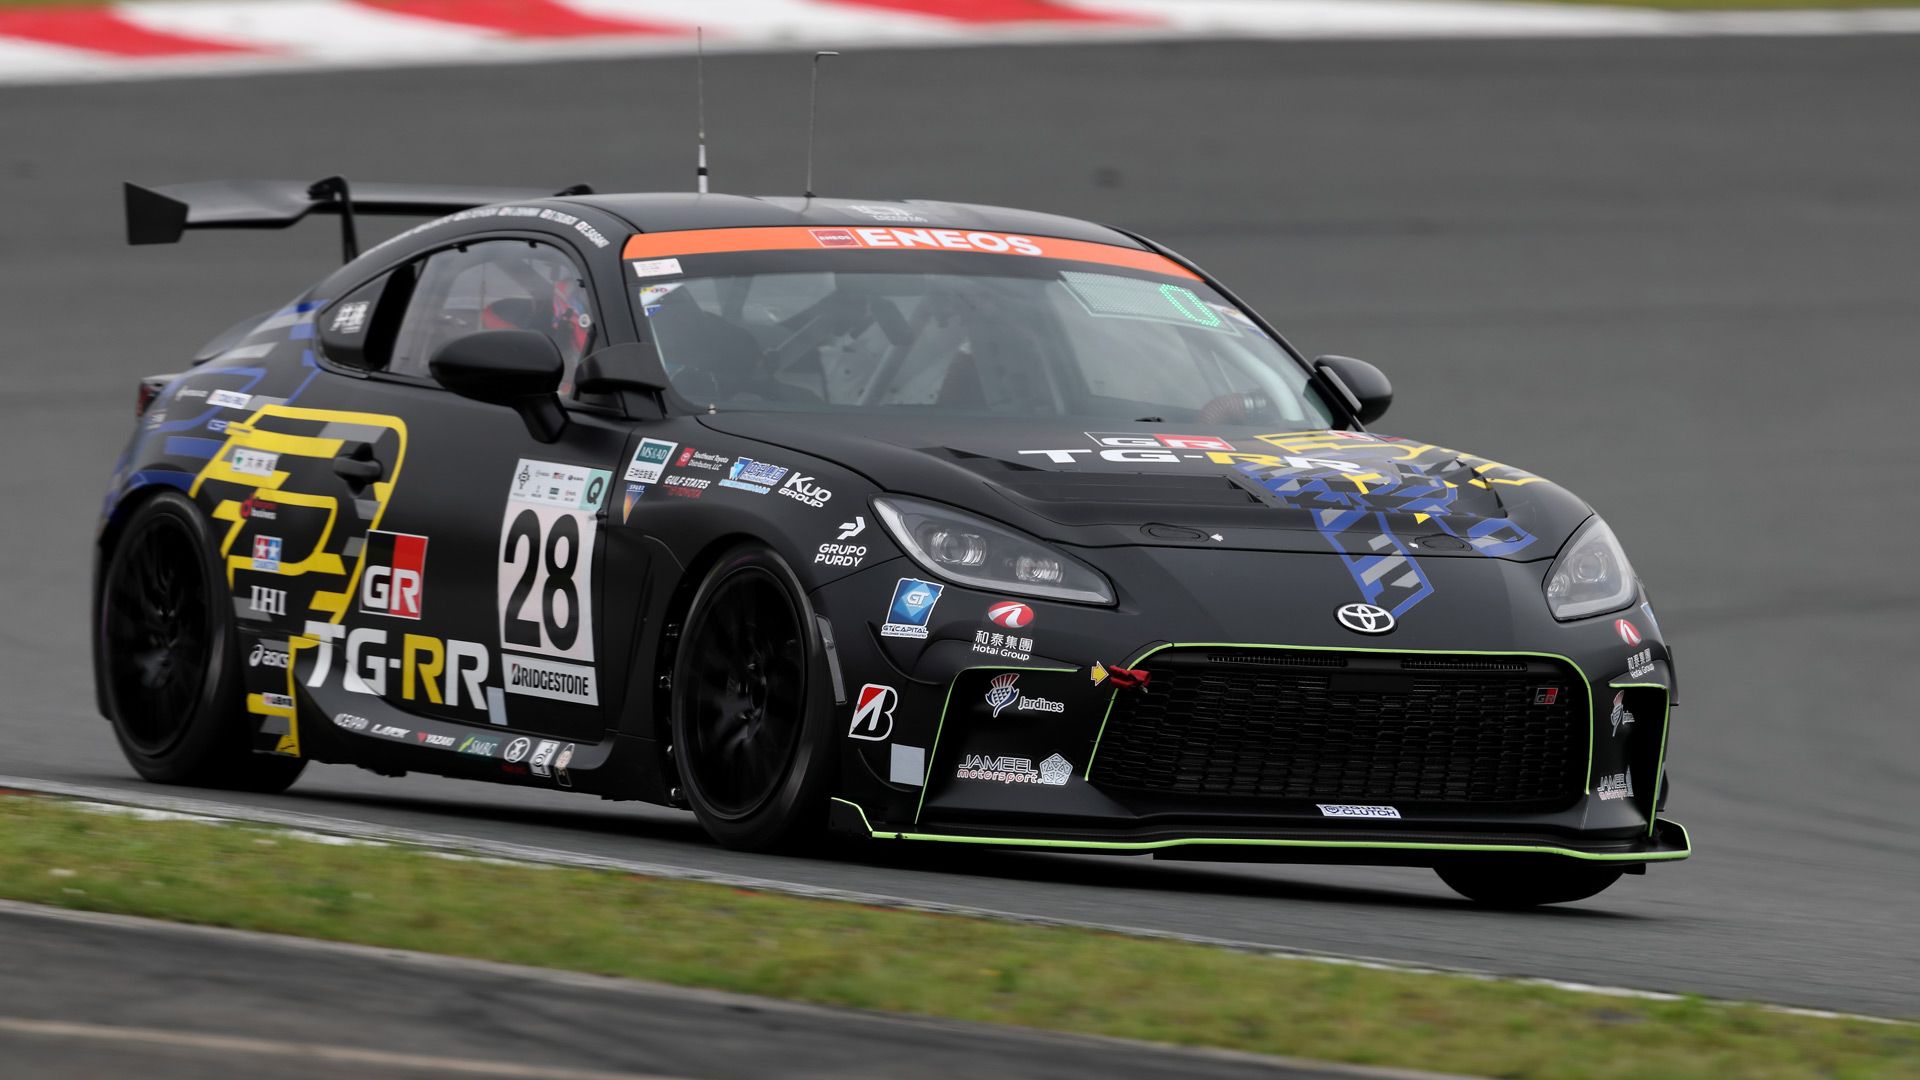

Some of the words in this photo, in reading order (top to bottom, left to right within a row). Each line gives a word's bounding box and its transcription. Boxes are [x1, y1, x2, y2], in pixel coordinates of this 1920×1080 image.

[855, 228, 1042, 257] ENEOS
[639, 446, 668, 460] MS&AD
[1101, 436, 1230, 450] GR
[1018, 449, 1362, 472] TG-RR
[587, 476, 604, 505] Q
[664, 475, 686, 487] GULF
[682, 478, 711, 490] STATES
[778, 487, 824, 508] GROUP
[814, 553, 863, 568] PURDY
[818, 543, 867, 557] GRUPO
[362, 565, 420, 613] GR
[503, 508, 580, 651] 28
[250, 585, 287, 615] IHI
[975, 630, 1033, 652] 和泰集團
[972, 643, 999, 655] Hotai
[1000, 648, 1030, 661] Group
[304, 620, 489, 710] TG-RR
[511, 663, 589, 696] BRIDGESTONE
[1018, 696, 1064, 713] Jardines
[958, 754, 1038, 774] JAMEEL
